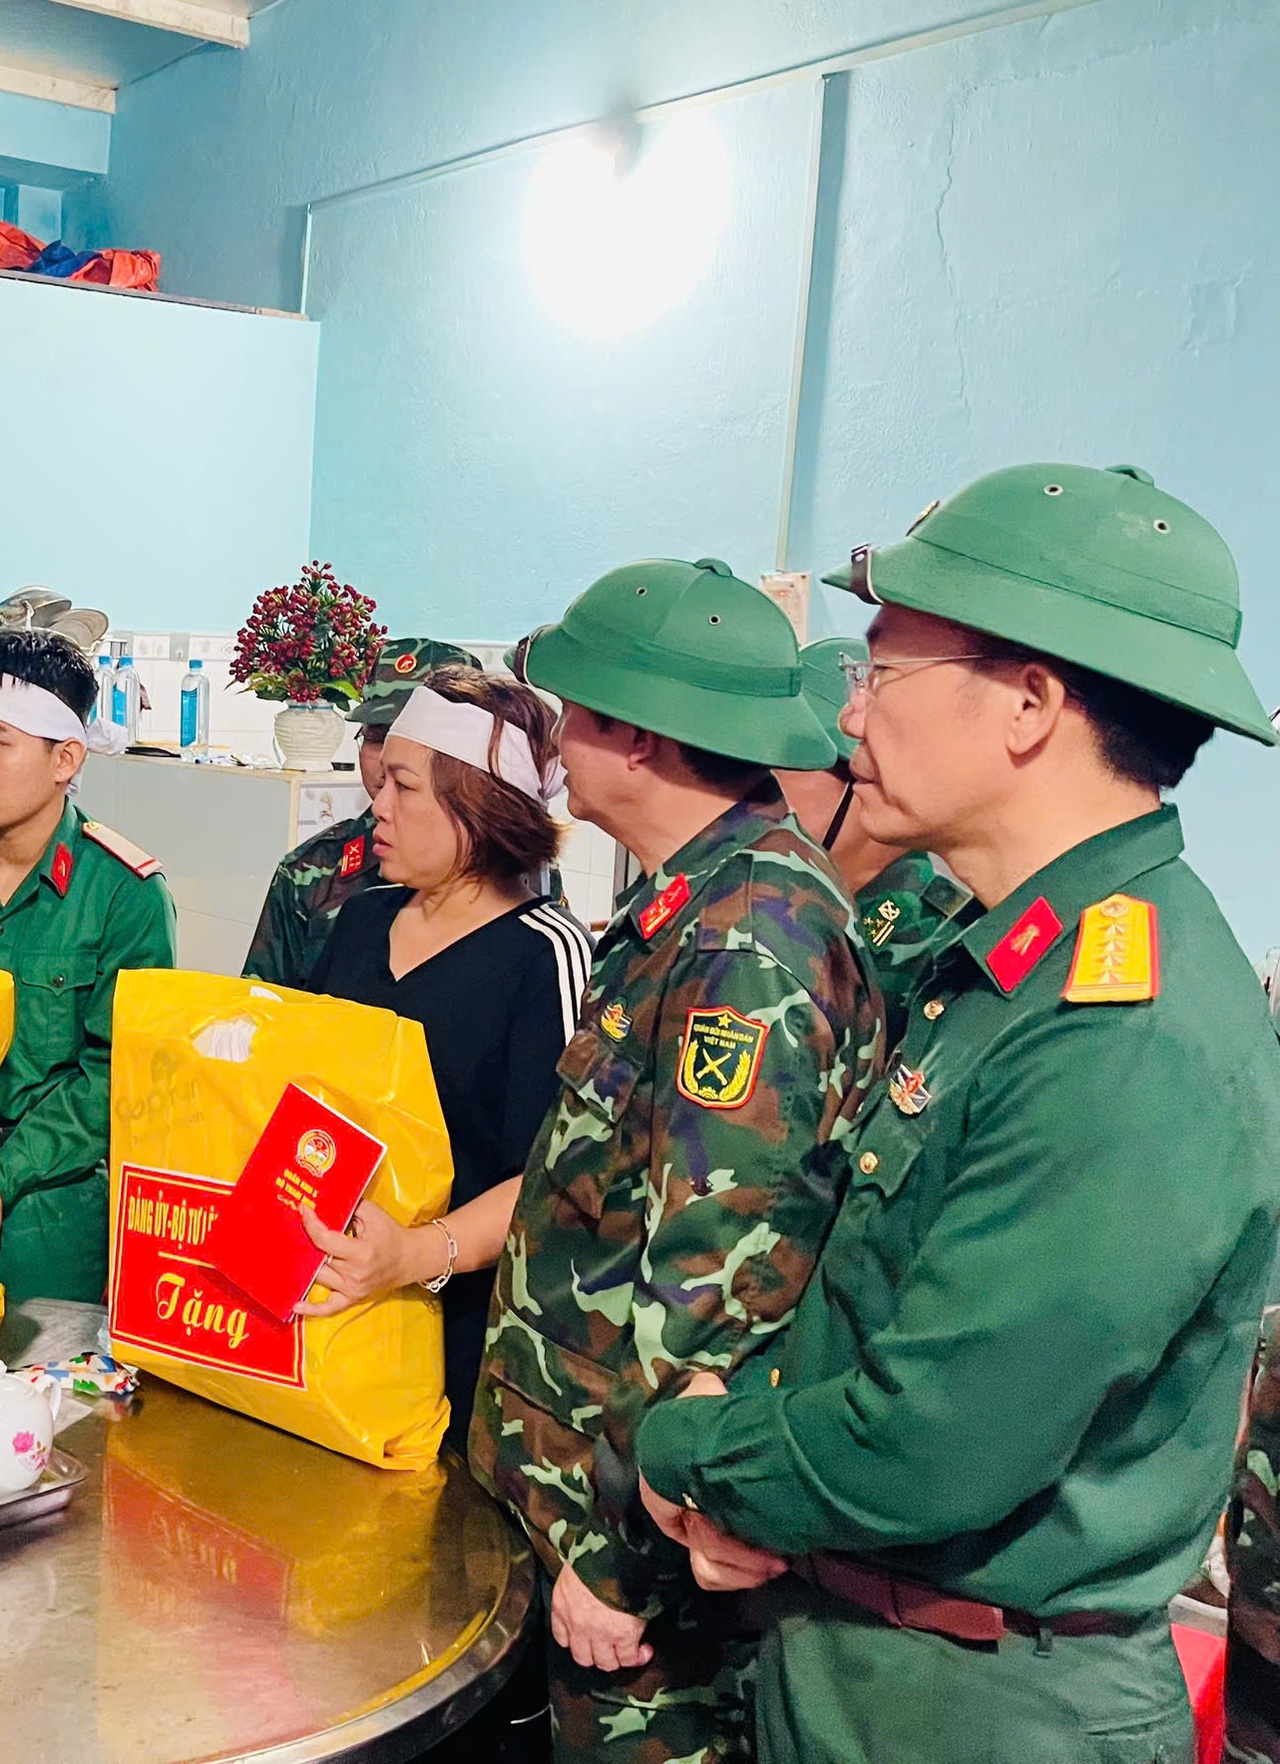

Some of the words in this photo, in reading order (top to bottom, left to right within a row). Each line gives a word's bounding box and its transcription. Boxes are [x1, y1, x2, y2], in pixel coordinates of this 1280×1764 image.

[128, 1185, 154, 1236] ĐẢNG
[187, 1206, 204, 1246] TƯ
[156, 1273, 250, 1350] Tặng
